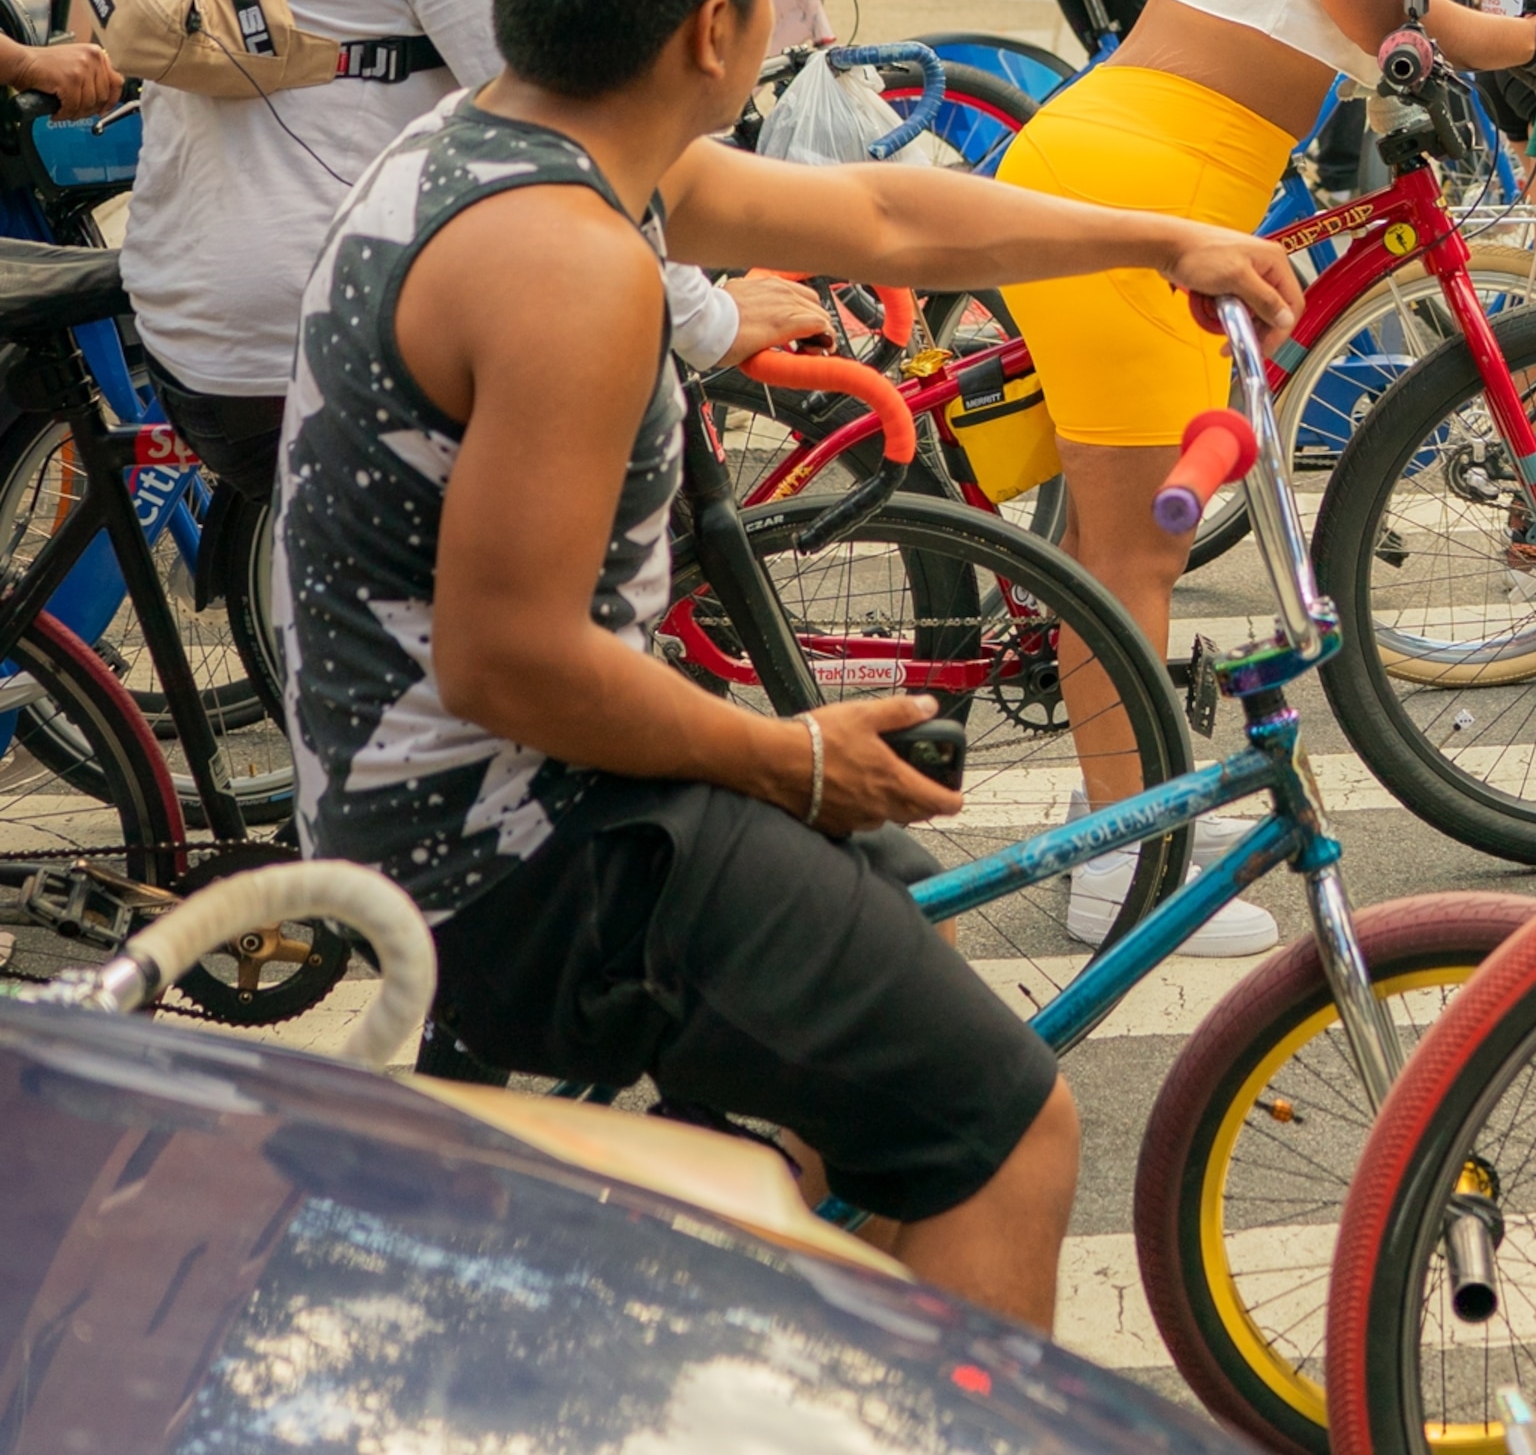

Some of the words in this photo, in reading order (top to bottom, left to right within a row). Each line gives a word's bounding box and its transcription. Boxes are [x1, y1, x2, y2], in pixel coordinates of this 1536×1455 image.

[1280, 221, 1342, 253] OUP'D
[1344, 204, 1374, 228] UP
[965, 391, 1002, 409] MERRITT
[746, 514, 785, 533] CZAR
[1071, 799, 1167, 848] VOLUME
